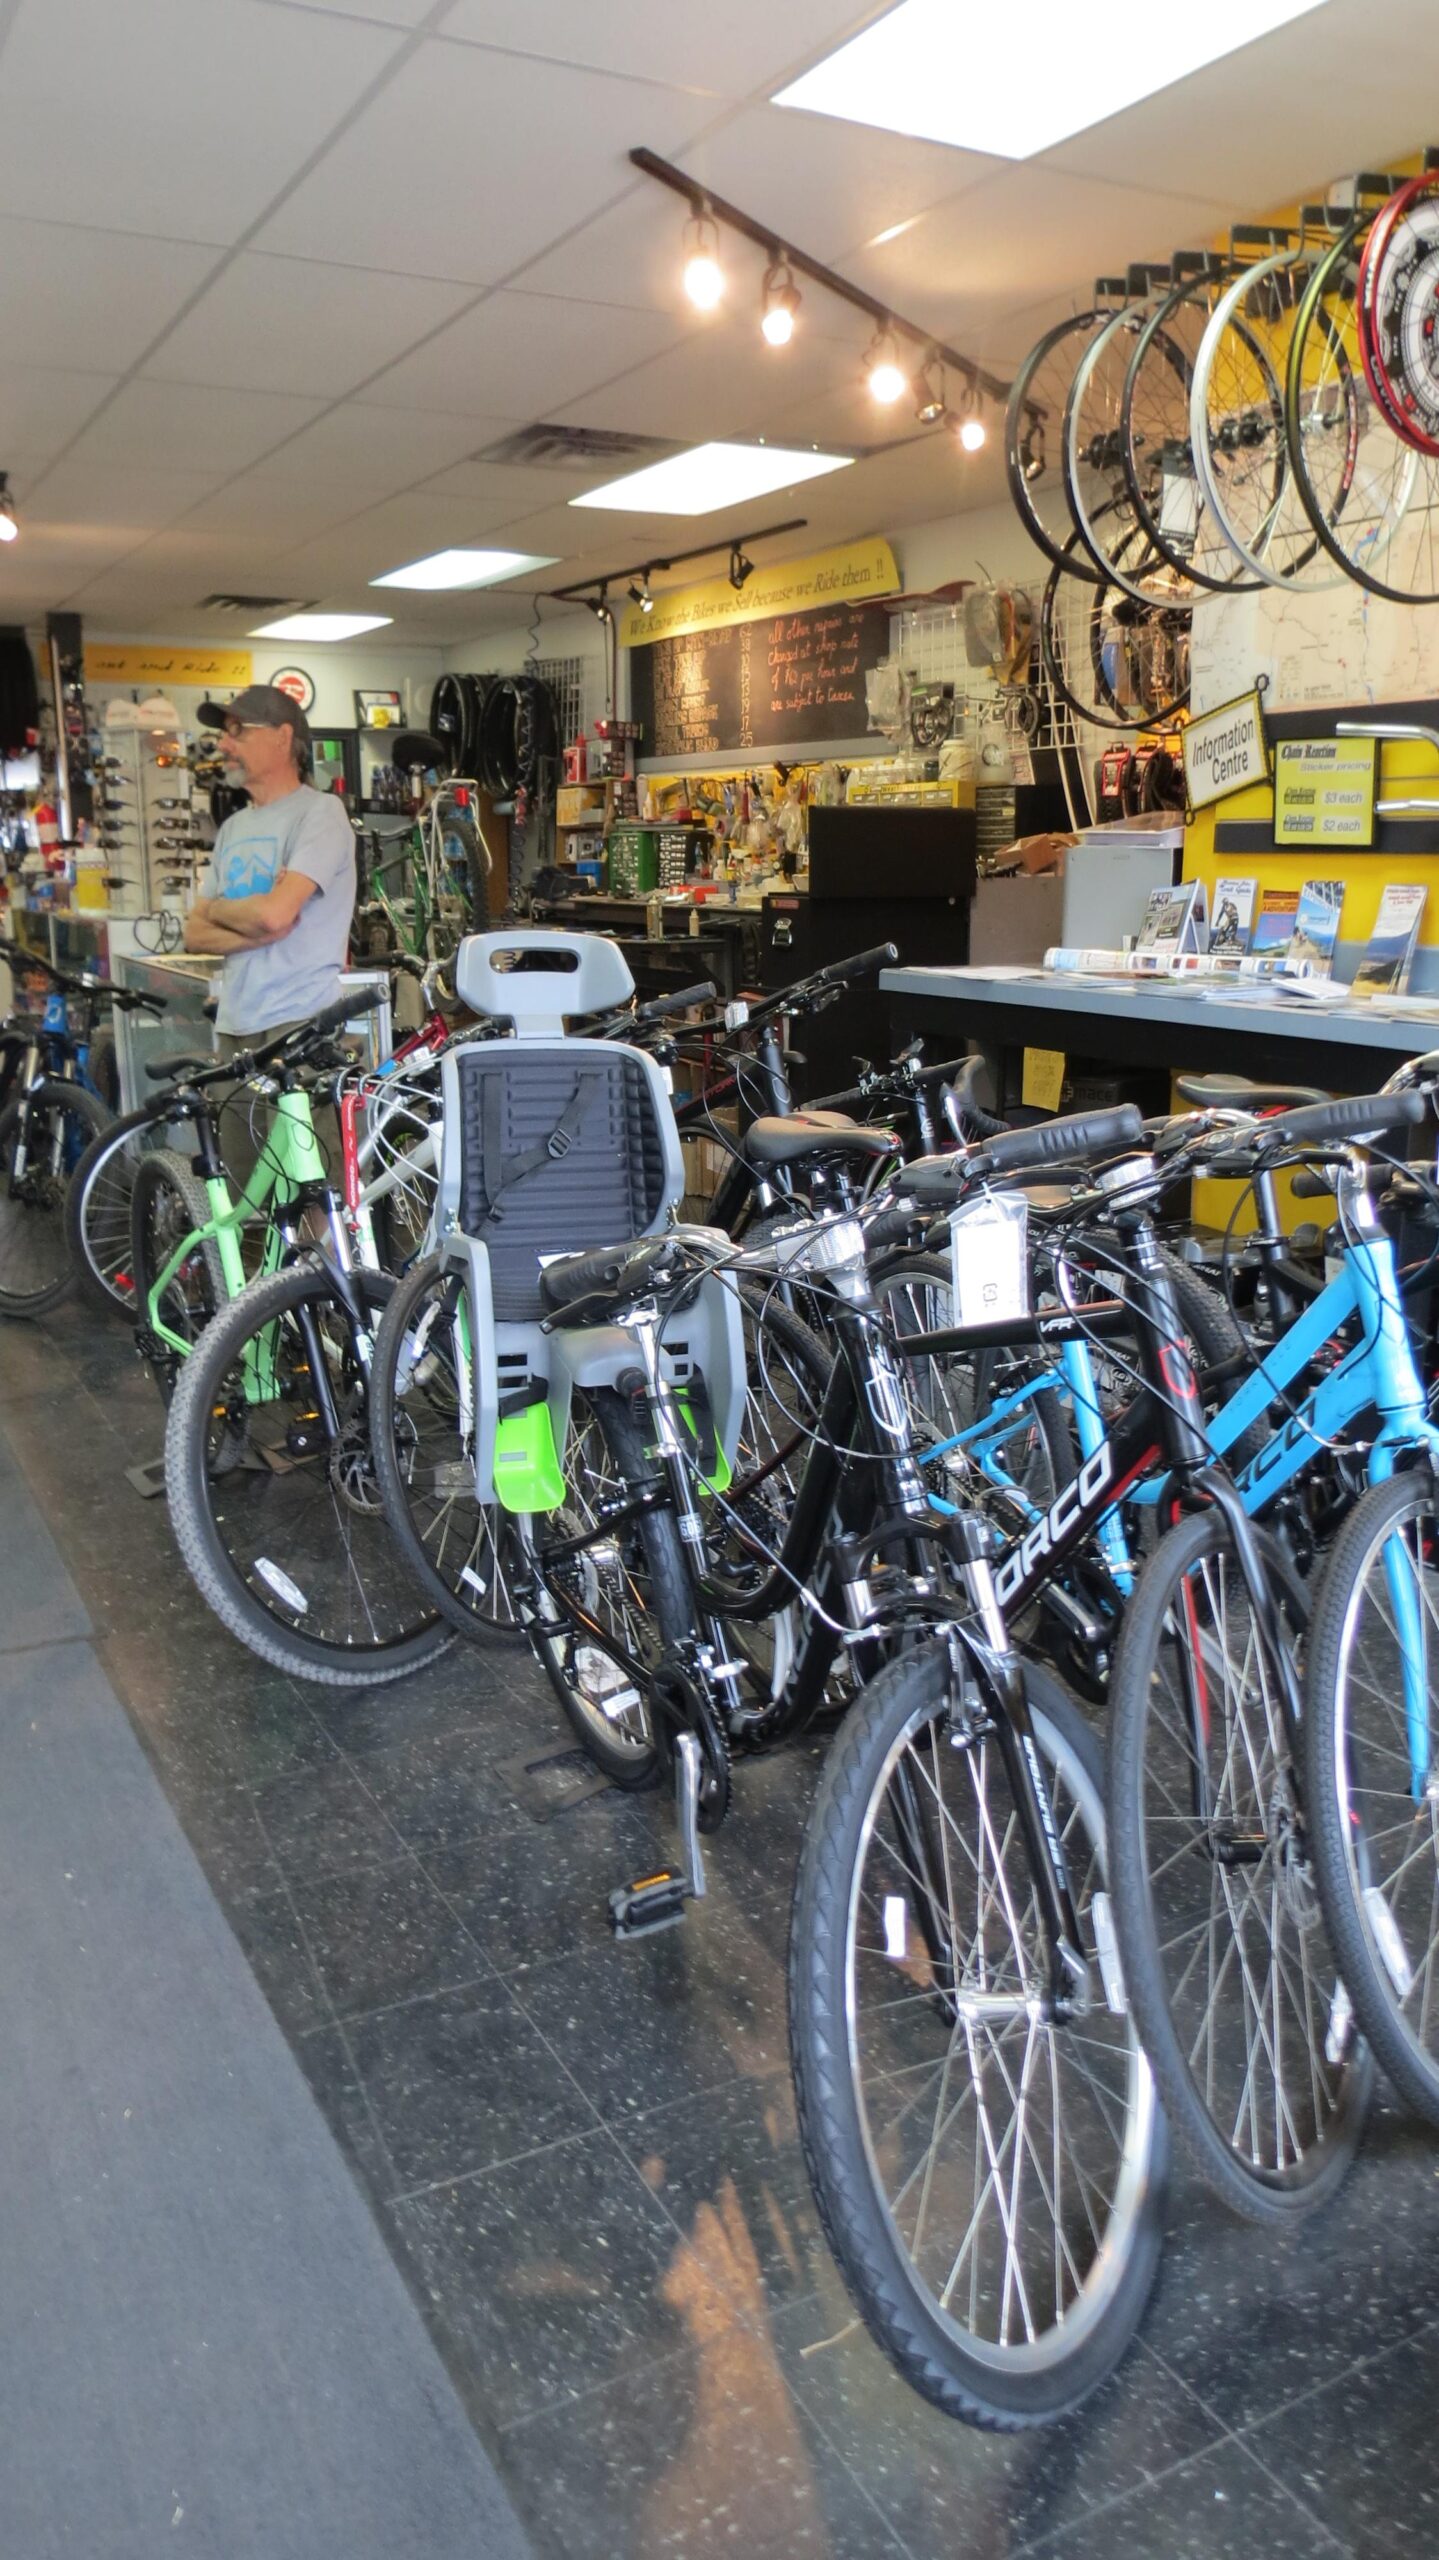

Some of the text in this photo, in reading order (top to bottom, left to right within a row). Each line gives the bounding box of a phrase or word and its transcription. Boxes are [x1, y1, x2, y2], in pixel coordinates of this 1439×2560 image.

[692, 602, 714, 622] Bikes
[717, 601, 734, 616] we
[752, 588, 791, 612] because
[796, 583, 812, 597] we
[814, 573, 841, 598] Ride
[842, 565, 871, 588] them
[740, 732, 753, 748] 25
[1192, 718, 1255, 768] Information
[1304, 743, 1337, 759] Reaction
[1211, 749, 1250, 785] Centre
[1336, 762, 1371, 772] pricing
[1324, 791, 1338, 804] $3
[1339, 792, 1362, 804] each
[1323, 819, 1337, 832] $2
[1337, 820, 1361, 832] each
[1039, 1317, 1076, 1333] VFR
[990, 1439, 1112, 1607] ORCO
